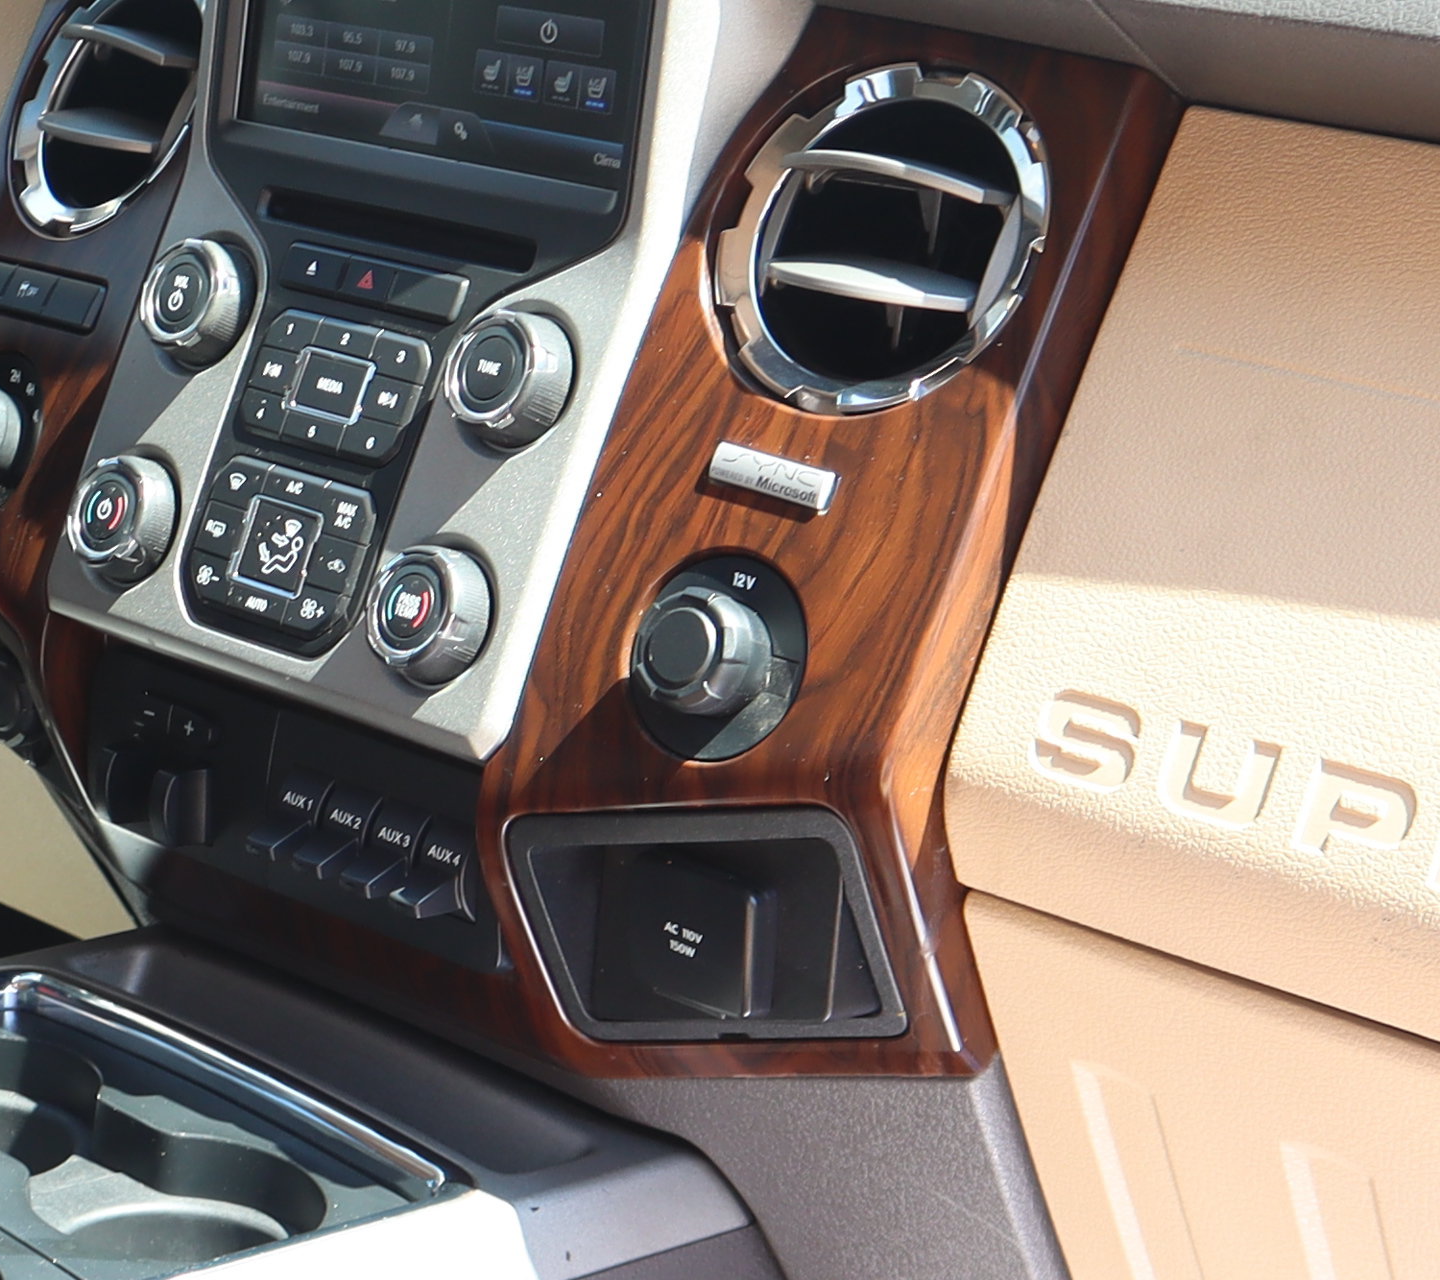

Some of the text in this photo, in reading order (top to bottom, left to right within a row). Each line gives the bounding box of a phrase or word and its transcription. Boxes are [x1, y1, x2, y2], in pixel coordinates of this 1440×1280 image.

[394, 39, 416, 54] 97.9
[391, 66, 415, 81] 107.9
[262, 93, 320, 114] Entertainment
[286, 323, 295, 335] 1
[340, 332, 351, 345] 2
[395, 350, 407, 363] 3
[476, 358, 502, 376] TUNE
[316, 376, 344, 395] MEDIA
[255, 407, 265, 419] 4
[307, 425, 317, 438] 5
[365, 436, 376, 450] 6
[722, 452, 820, 488] SYNC
[285, 480, 304, 495] A/C
[755, 475, 817, 504] Microsoft
[335, 501, 359, 517] MAX
[334, 515, 352, 530] A/C
[732, 571, 757, 590] 12V
[244, 595, 268, 612] AUTO
[398, 592, 422, 609] PASS
[394, 603, 419, 620] TEMP
[282, 790, 314, 812] AUX 1
[329, 807, 362, 831] AUX 2
[377, 826, 412, 848] AUX 3
[427, 844, 462, 867] AUX 4
[663, 921, 704, 944] AC 110V
[669, 939, 697, 958] 150W
